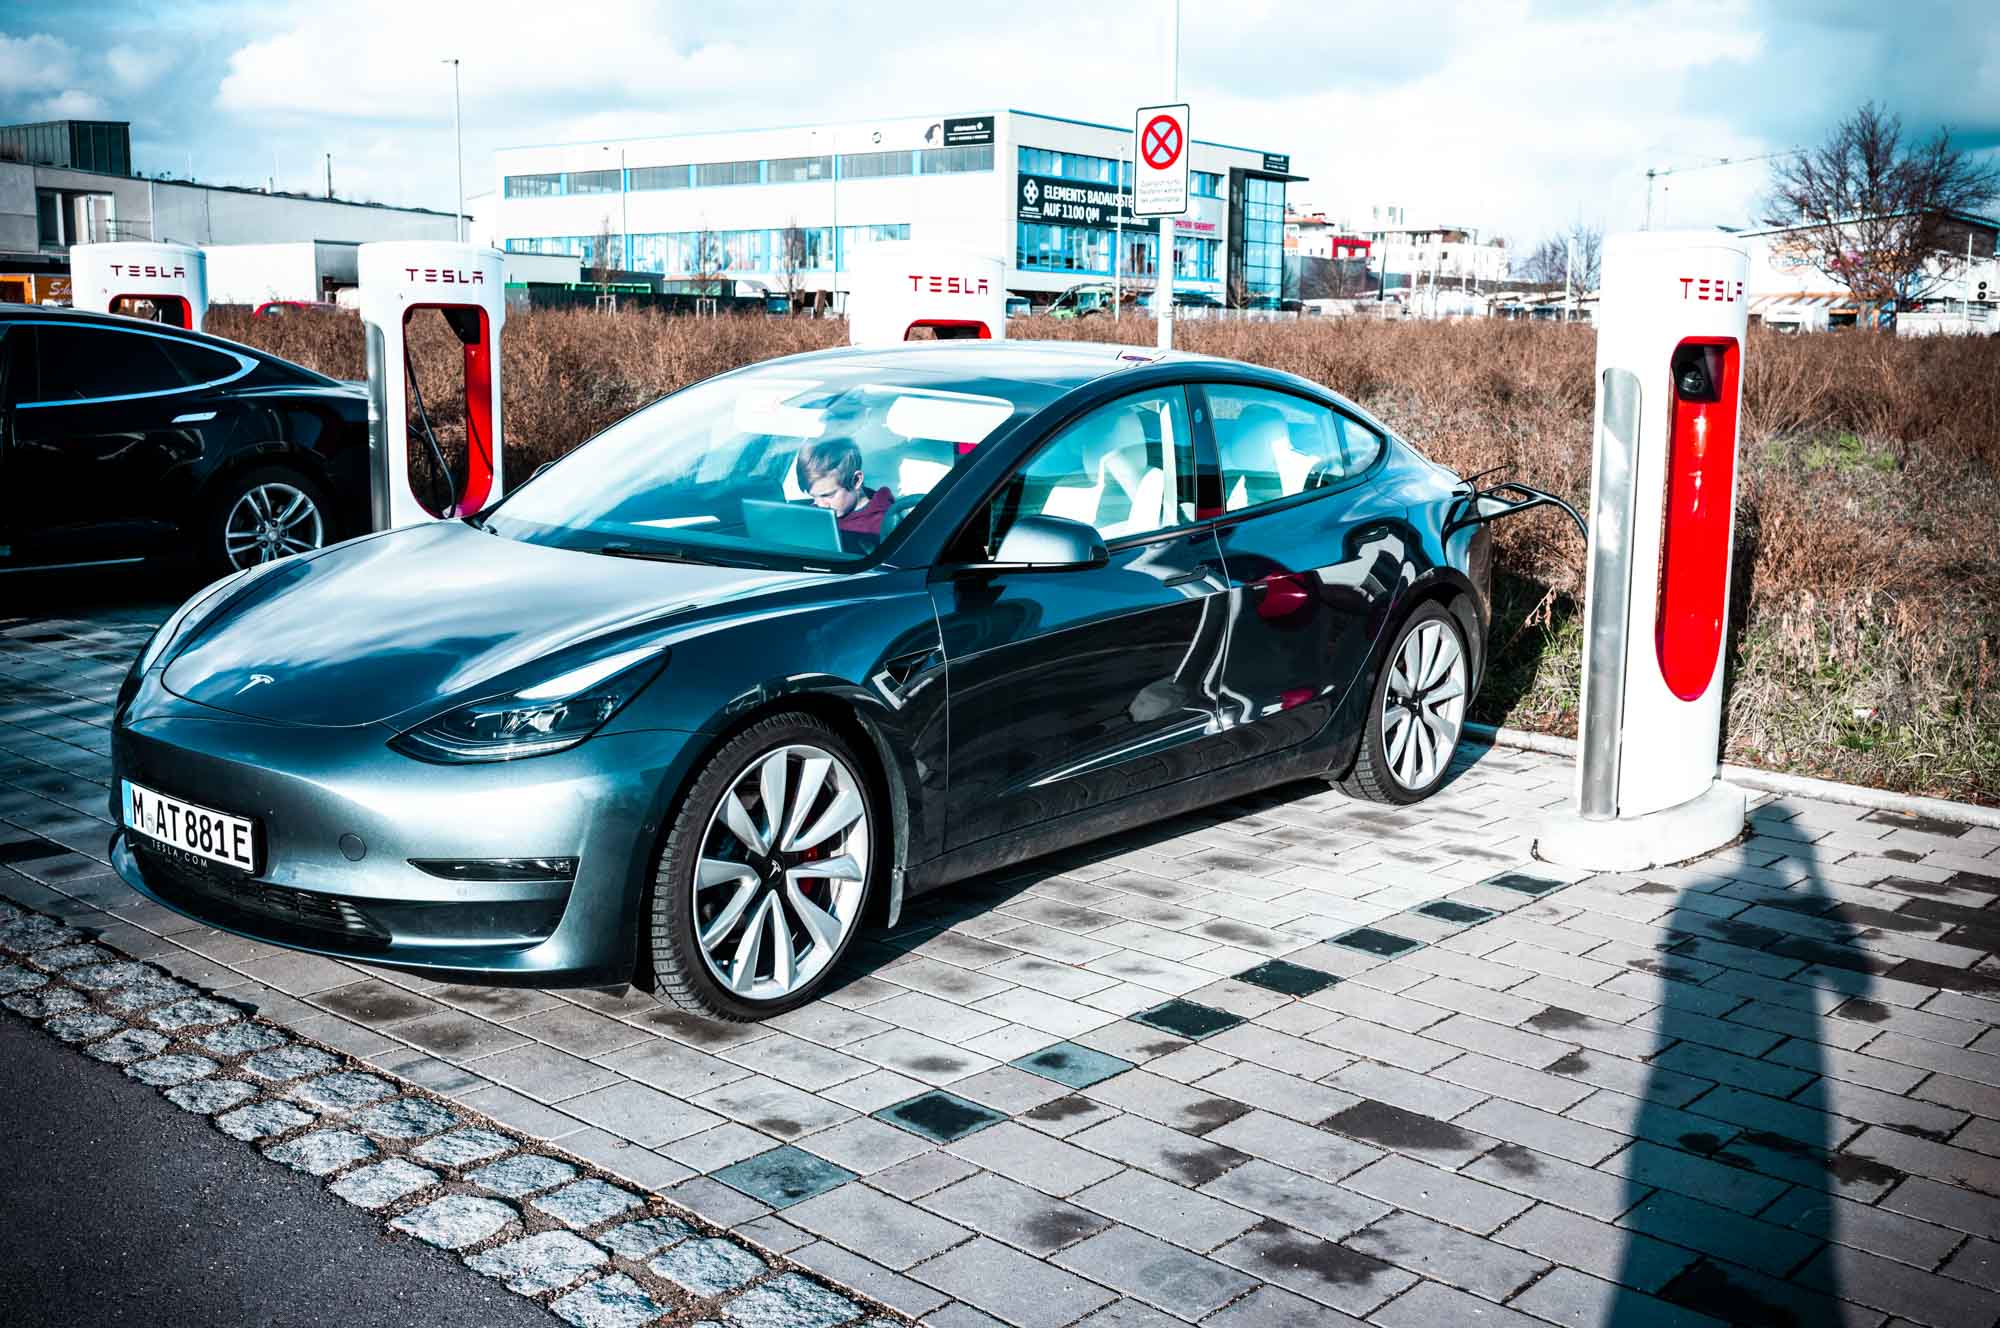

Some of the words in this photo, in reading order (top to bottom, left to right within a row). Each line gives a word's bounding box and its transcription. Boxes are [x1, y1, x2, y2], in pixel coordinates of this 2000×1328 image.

[1044, 184, 1087, 204] ELEMENTS
[1043, 201, 1061, 217] AUF
[1062, 203, 1085, 220] 1100
[1085, 205, 1100, 223] QM
[110, 264, 185, 279] TESLA
[405, 268, 484, 285] TESLA
[908, 275, 988, 296] TESLA
[132, 789, 144, 828] M
